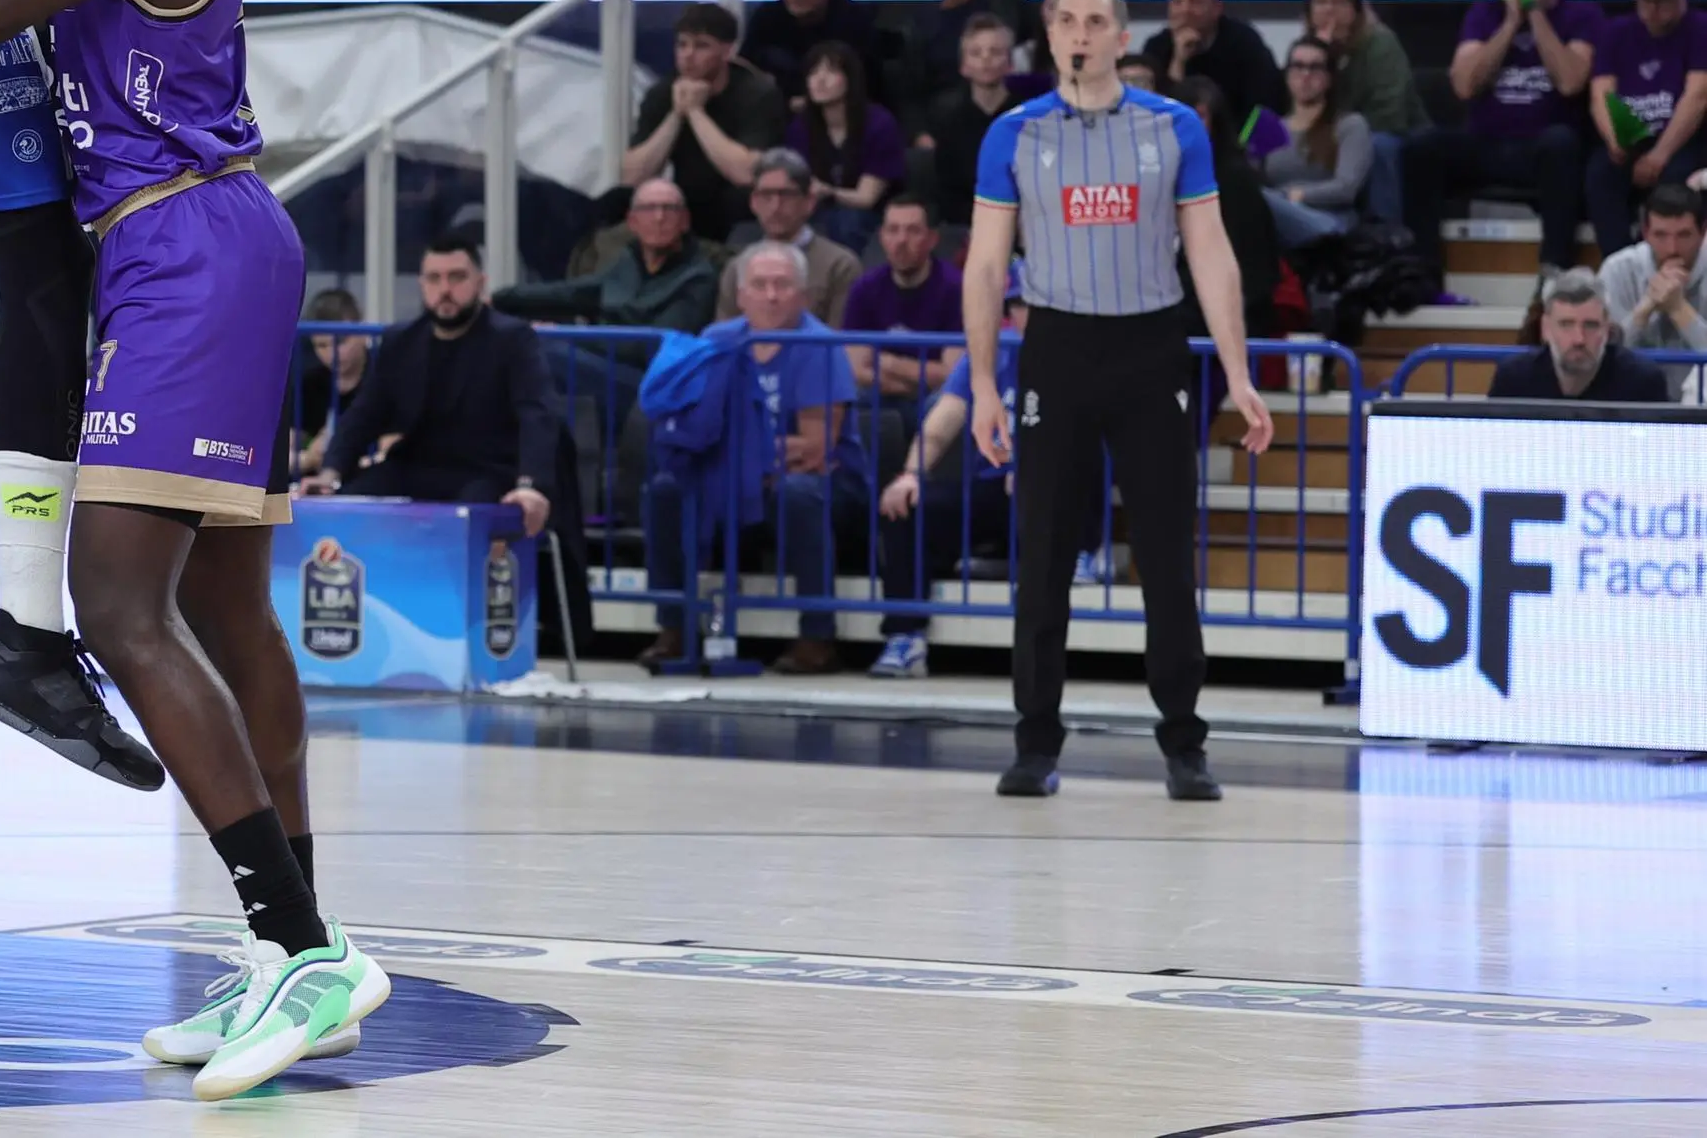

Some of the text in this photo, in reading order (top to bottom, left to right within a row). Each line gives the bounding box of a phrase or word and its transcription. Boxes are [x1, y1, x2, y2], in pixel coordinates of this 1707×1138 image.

[1068, 185, 1133, 204] ATTAL
[1069, 204, 1133, 218] GROUP
[87, 411, 136, 435] ITAS
[86, 433, 119, 445] MUTUA
[209, 440, 230, 457] BTS
[12, 505, 50, 517] PRS
[308, 586, 357, 610] LBA
[1373, 485, 1566, 699] SF
